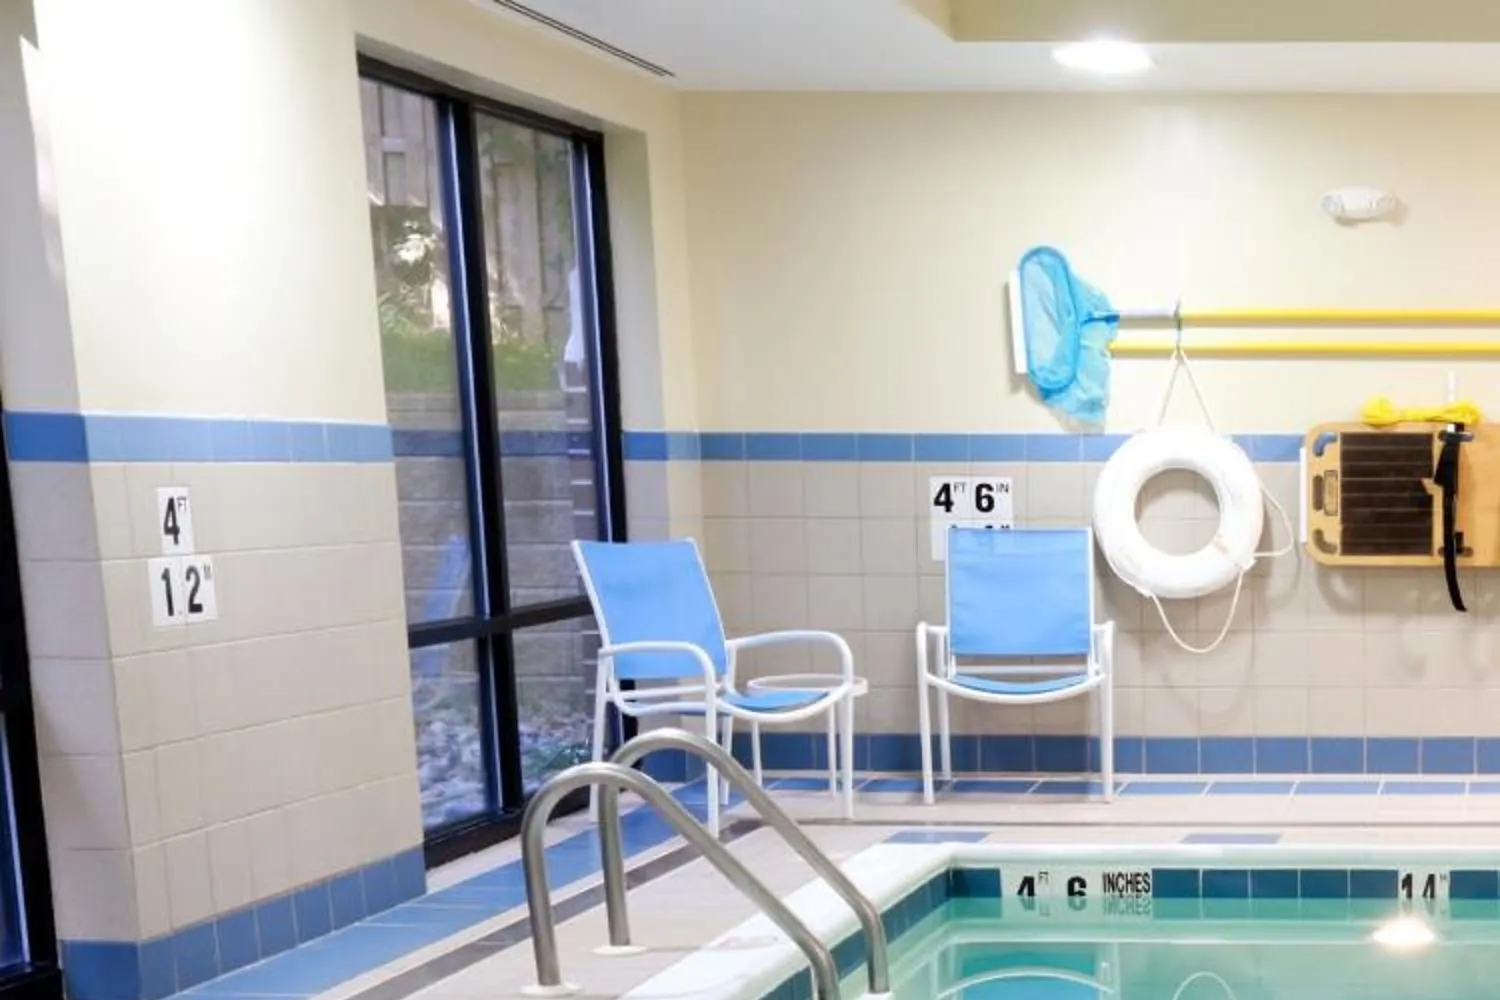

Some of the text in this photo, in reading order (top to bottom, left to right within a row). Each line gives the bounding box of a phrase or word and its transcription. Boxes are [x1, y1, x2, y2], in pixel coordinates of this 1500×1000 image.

[933, 482, 955, 513] 4
[975, 482, 995, 513] 6
[163, 497, 180, 545] 4
[1102, 871, 1151, 894] INCHES
